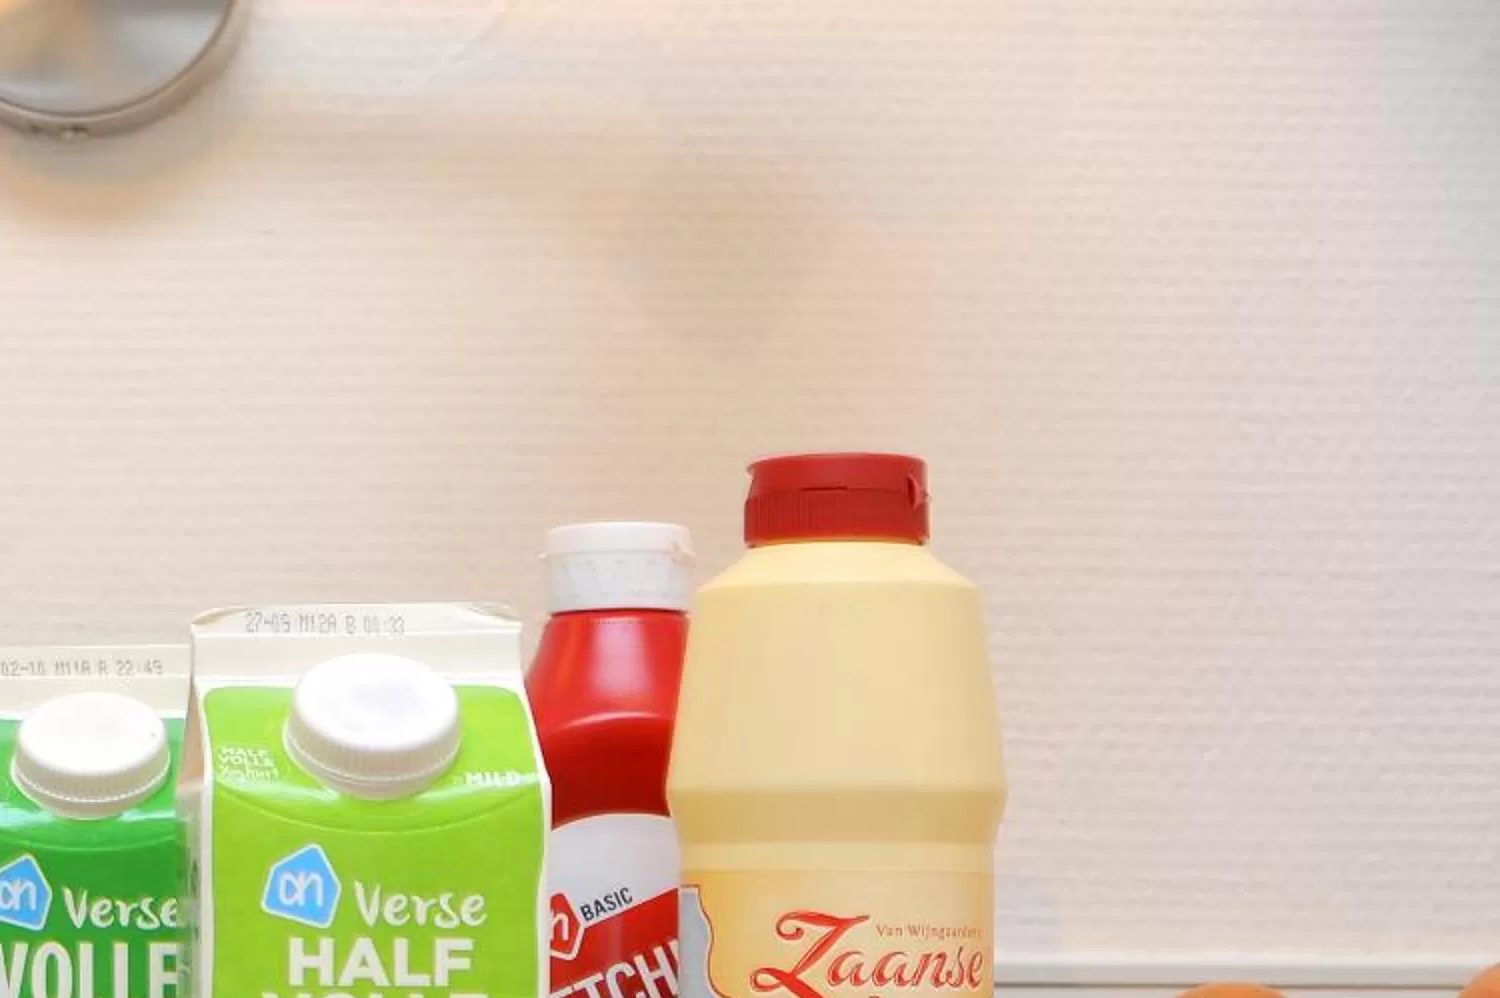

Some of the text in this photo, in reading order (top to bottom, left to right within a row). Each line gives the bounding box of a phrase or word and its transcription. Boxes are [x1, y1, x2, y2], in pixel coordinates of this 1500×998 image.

[62, 886, 179, 931] Verse
[354, 879, 489, 930] Verse
[580, 887, 633, 922] BASIC
[876, 923, 903, 938] Van
[288, 936, 476, 987] HALF
